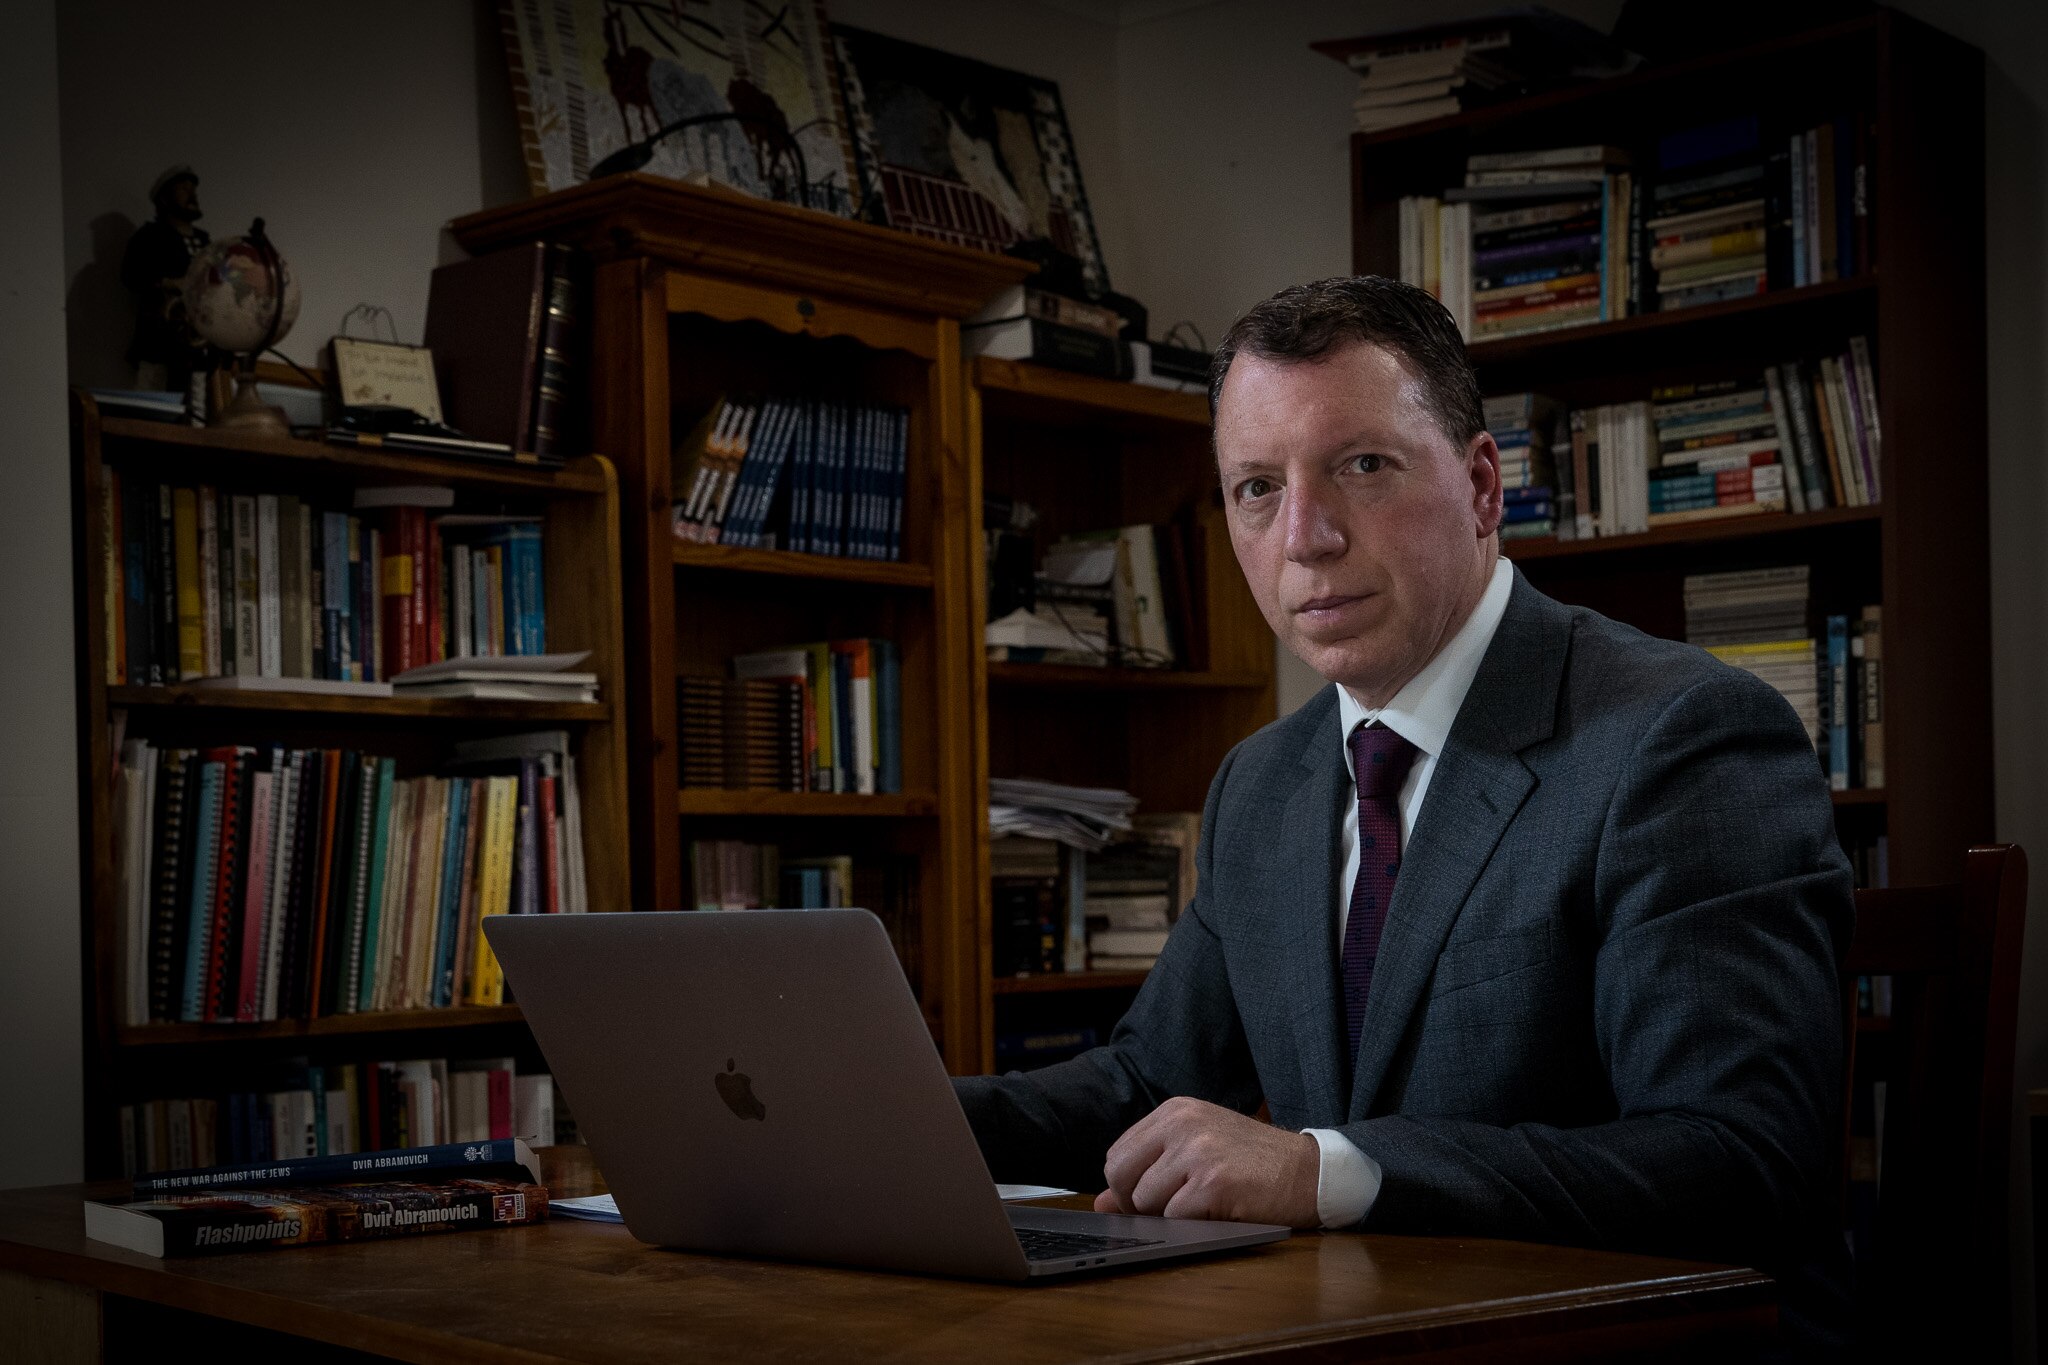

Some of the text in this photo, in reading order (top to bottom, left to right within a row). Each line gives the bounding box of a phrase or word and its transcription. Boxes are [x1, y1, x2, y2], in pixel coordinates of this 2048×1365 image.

[352, 1153, 429, 1170] DVIR ABRAMOVICH
[152, 1166, 291, 1190] THE NEW WAR AGAINST THE JEWS
[363, 1211, 392, 1229] Dvir
[394, 1203, 479, 1226] Abramovich
[194, 1220, 301, 1247] Flashpoints
